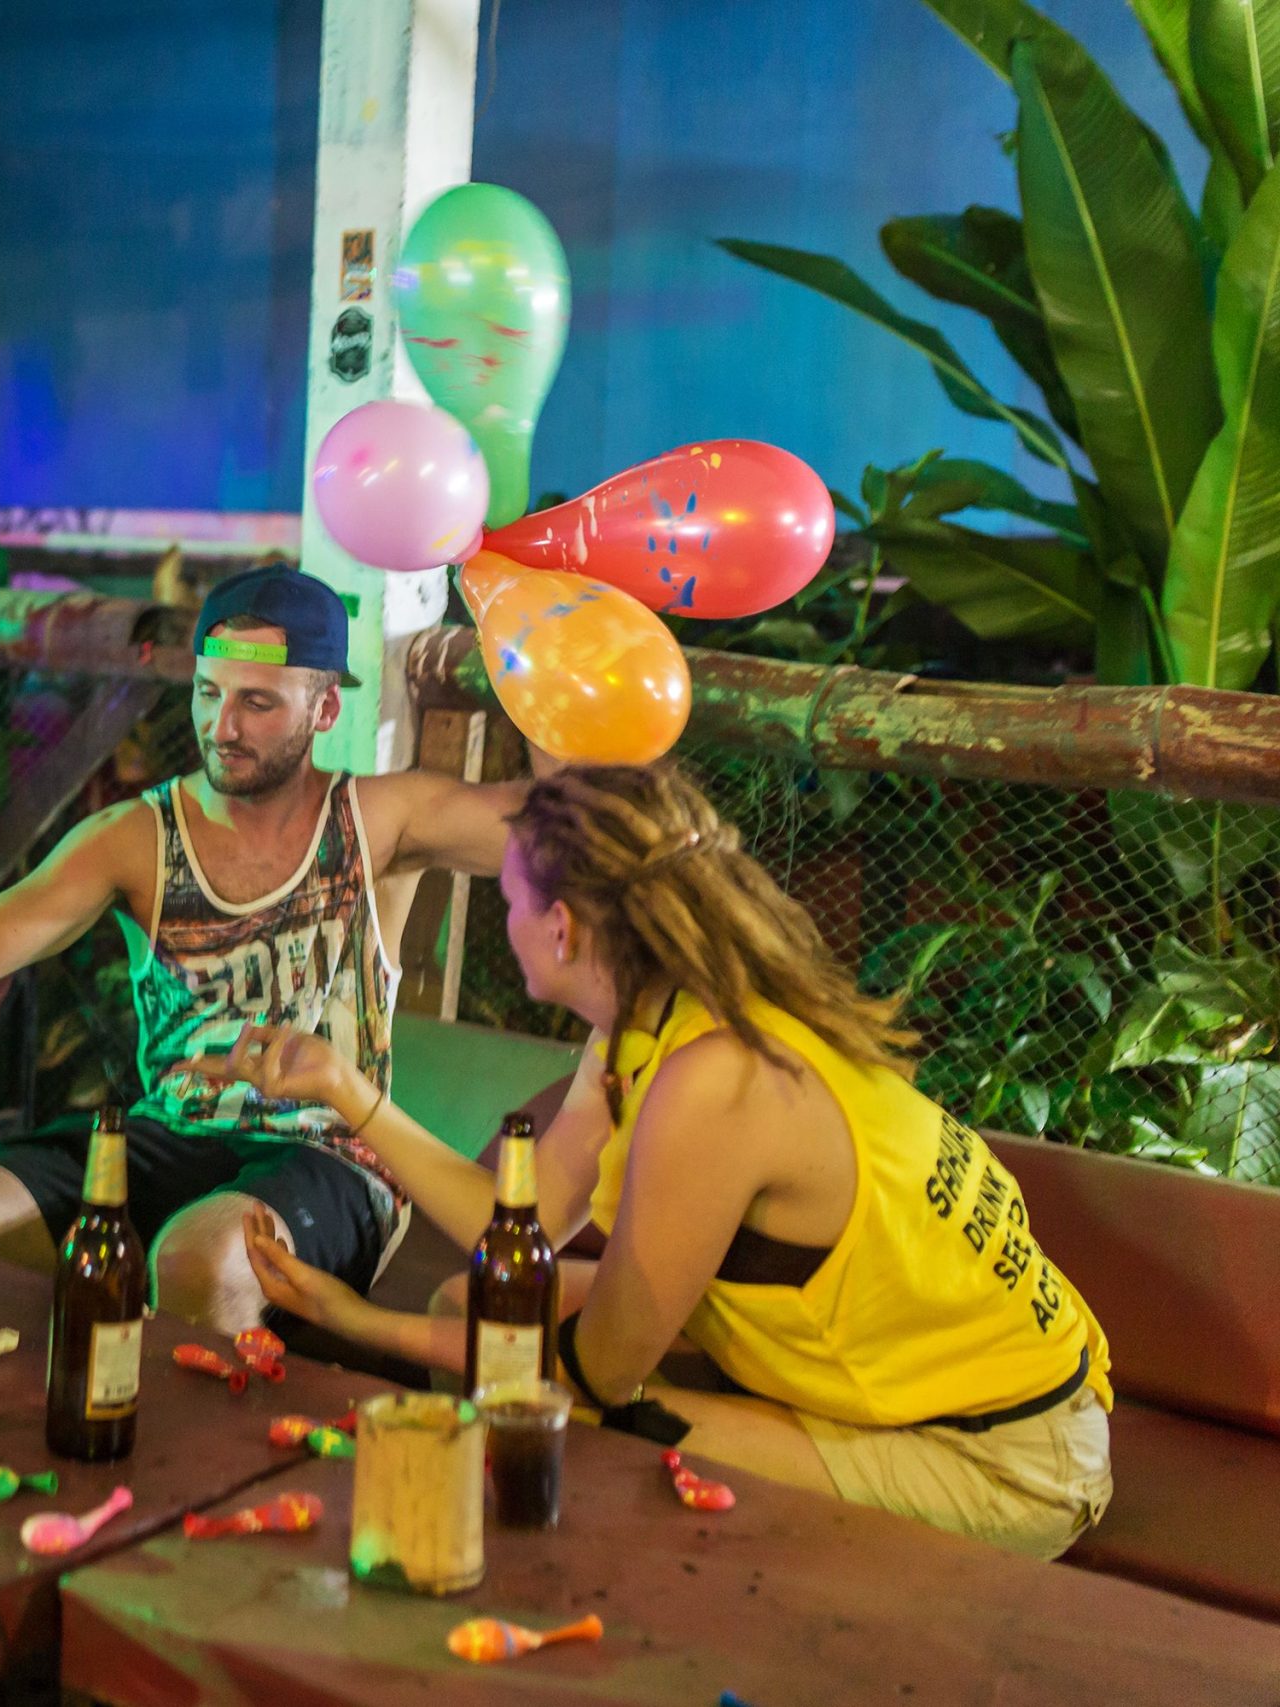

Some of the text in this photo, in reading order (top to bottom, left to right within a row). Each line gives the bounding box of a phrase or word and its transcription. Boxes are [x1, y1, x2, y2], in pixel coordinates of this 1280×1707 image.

[963, 1165, 1009, 1254] DRINK
[993, 1229, 1031, 1291] SEE
[1031, 1263, 1062, 1333] ACT
